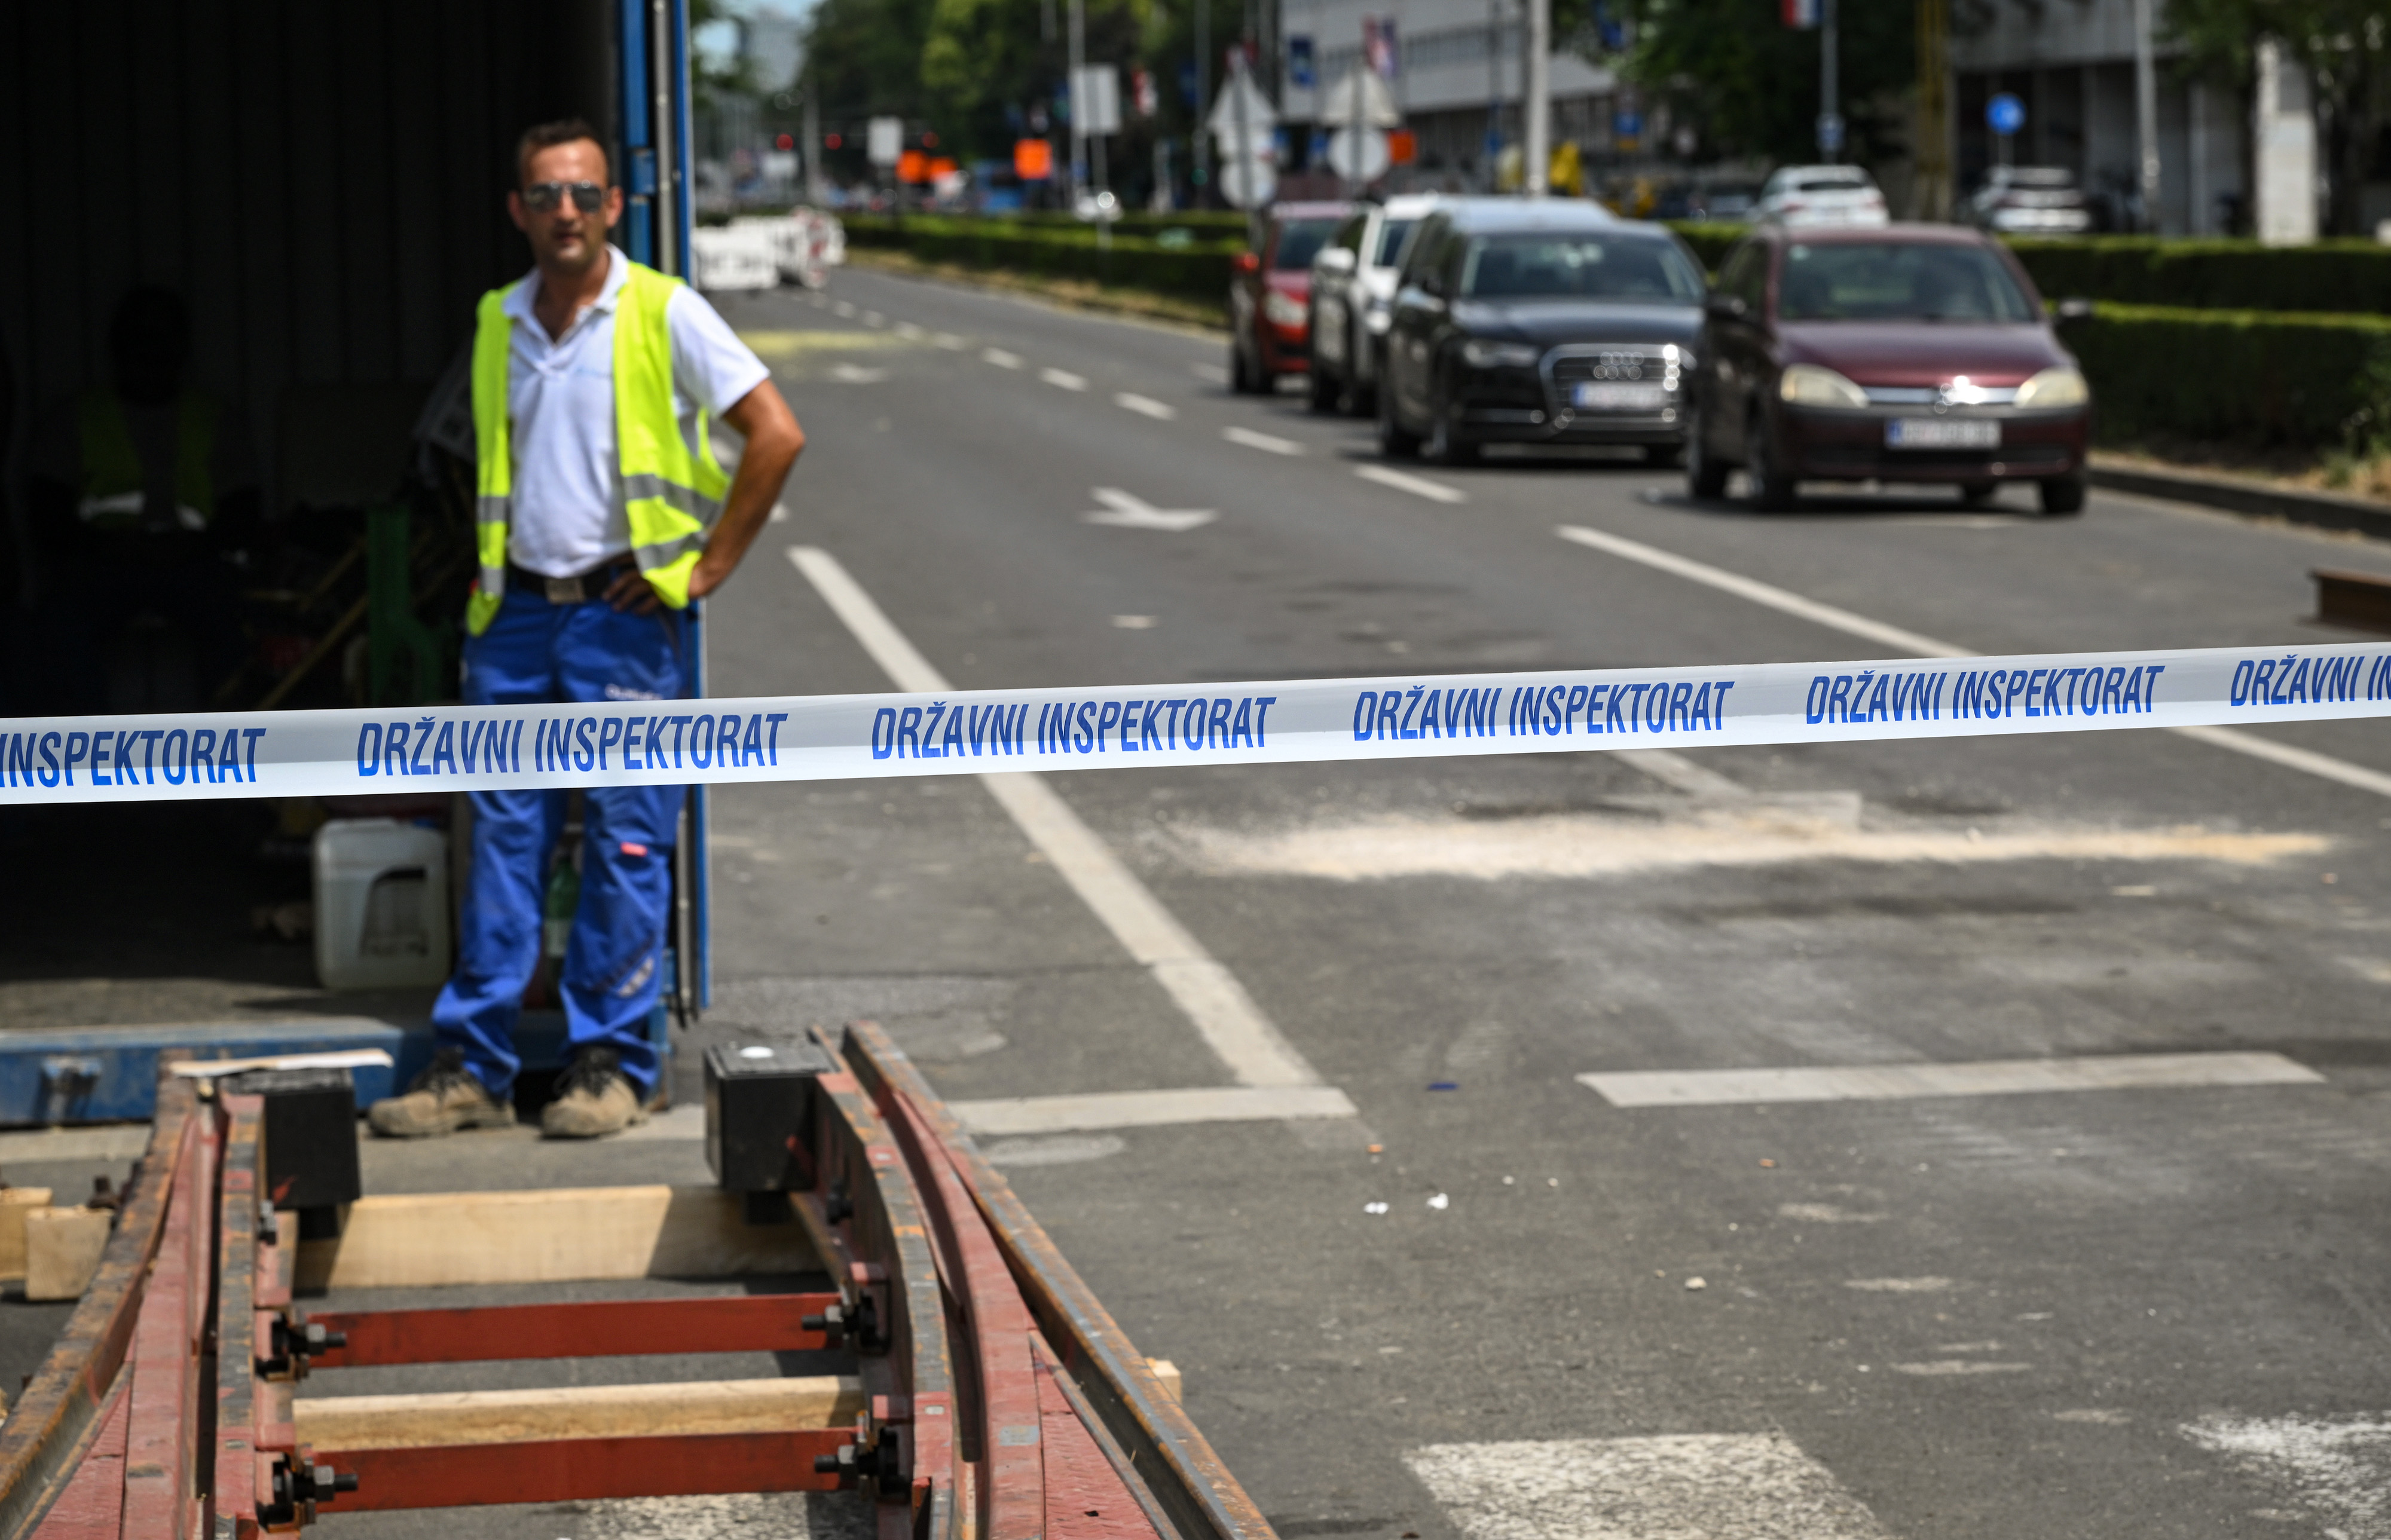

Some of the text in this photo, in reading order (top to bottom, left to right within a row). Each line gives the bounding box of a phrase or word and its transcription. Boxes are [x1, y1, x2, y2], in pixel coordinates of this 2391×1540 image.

[1806, 665, 2166, 725] DRŽAVNI INSPEKTORAT
[2230, 654, 2365, 707] DRŽAVNI
[872, 697, 1277, 760] DRŽAVNI INSPEKTORAT
[1353, 681, 1736, 742] DRŽAVNI INSPEKTORAT
[0, 728, 267, 788] INSPEKTORAT
[357, 709, 788, 777] DRŽAVNI INSPEKTORAT
